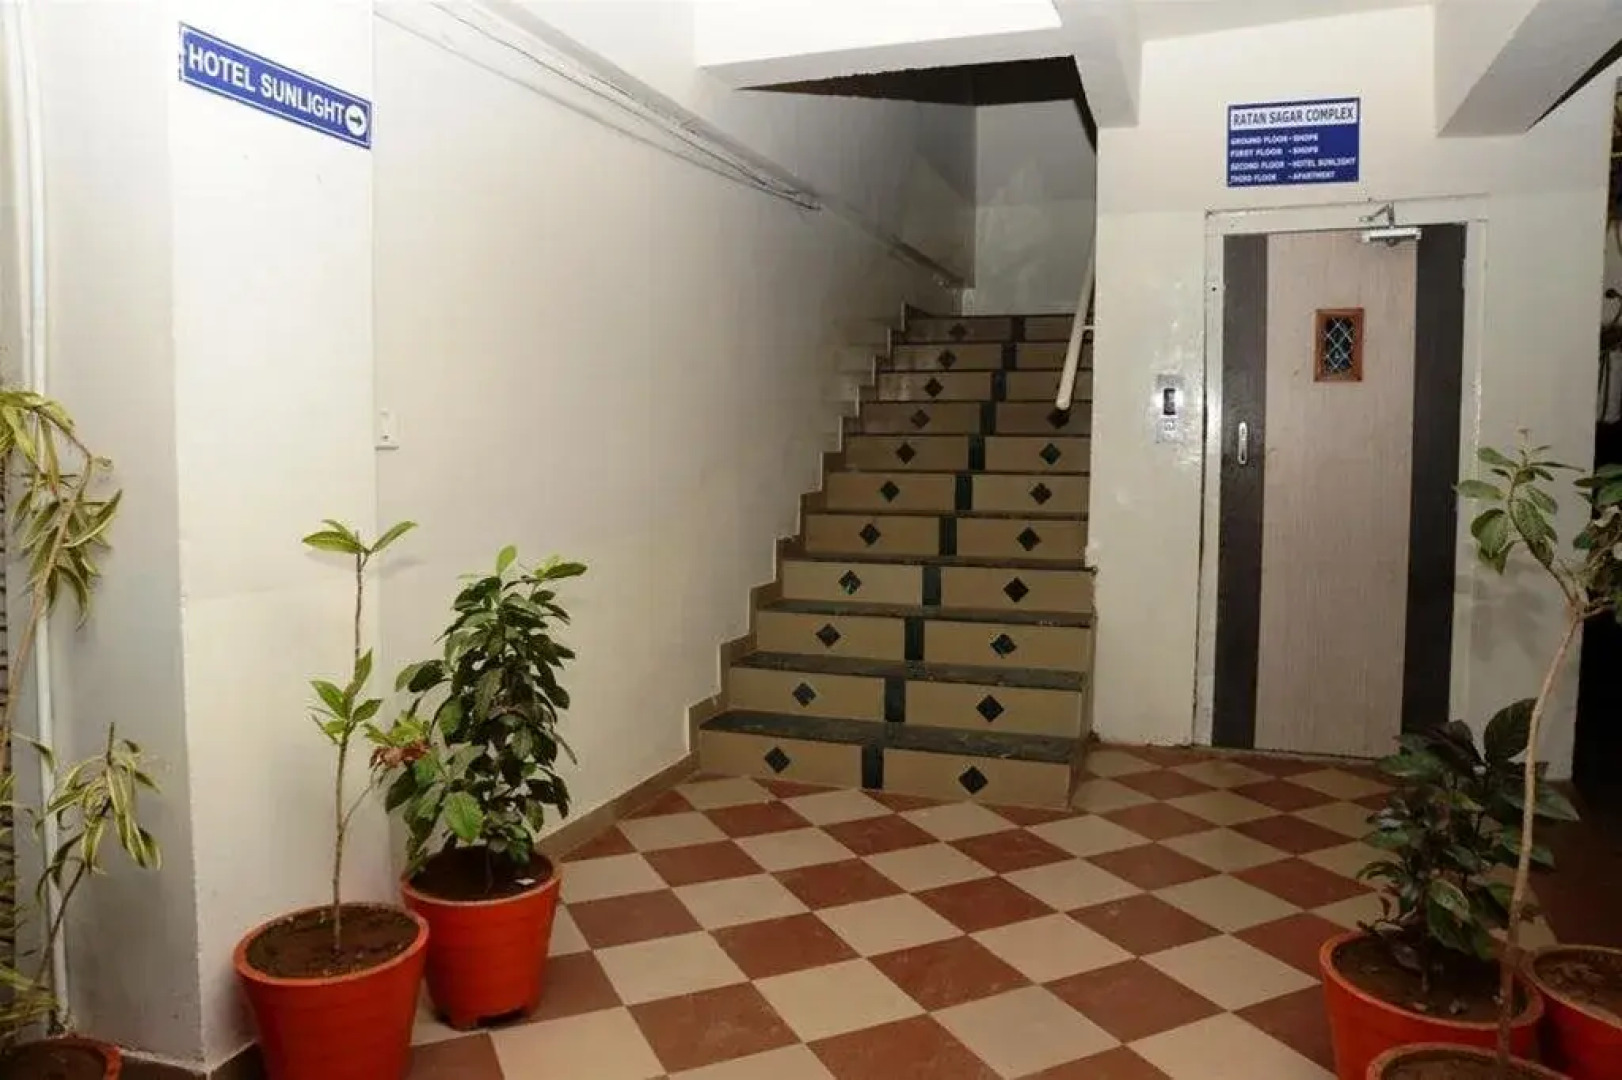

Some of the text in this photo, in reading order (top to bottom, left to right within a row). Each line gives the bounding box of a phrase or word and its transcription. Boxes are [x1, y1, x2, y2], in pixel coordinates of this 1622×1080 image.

[189, 43, 345, 126] HOTEL SUNLIGHT
[1234, 107, 1354, 126] RATAN SAGAR COMPLEX
[1231, 137, 1262, 145] GROUND
[1263, 135, 1288, 144] FLOOR
[1231, 148, 1254, 157] FIRST
[1255, 147, 1283, 156] FLOOR
[1231, 162, 1259, 171] SECOND
[1260, 160, 1284, 169] FLOOR
[1293, 159, 1316, 168] HOTEL
[1317, 157, 1355, 167] SUNLIGHT
[1254, 173, 1277, 182] FLOOR
